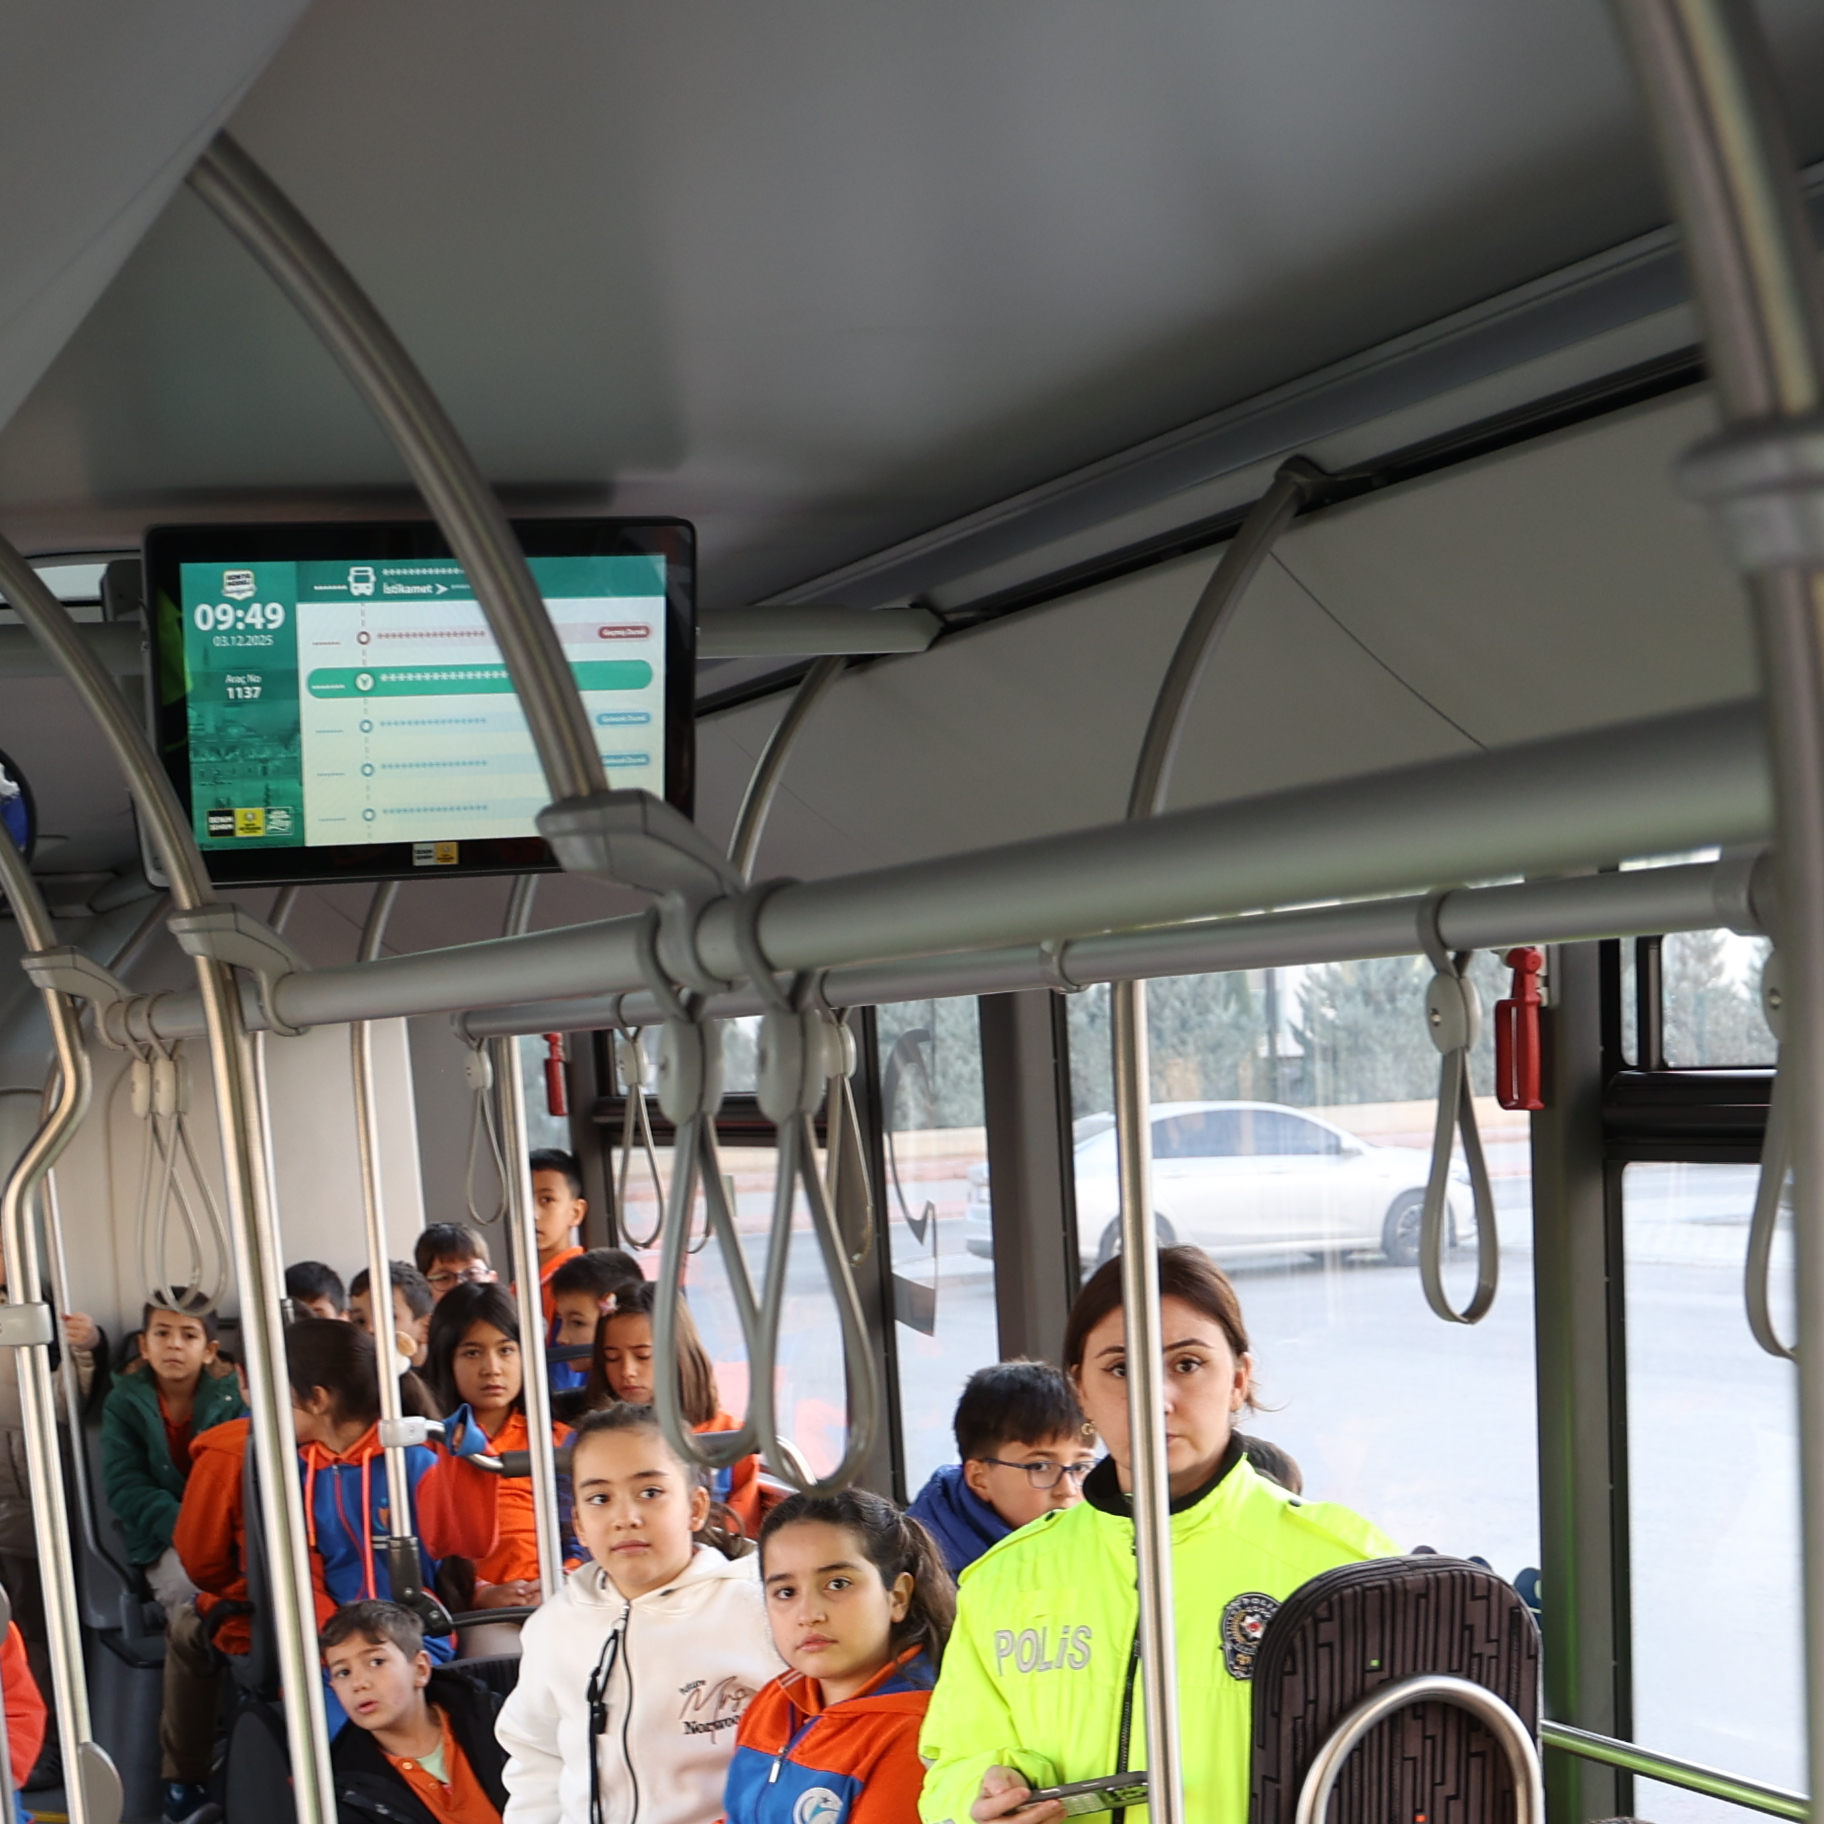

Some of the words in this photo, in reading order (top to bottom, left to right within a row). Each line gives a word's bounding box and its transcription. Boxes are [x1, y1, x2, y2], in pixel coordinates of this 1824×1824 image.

[194, 602, 285, 631] 09:49
[212, 634, 274, 647] 03.12.2025
[226, 686, 262, 699] 1137
